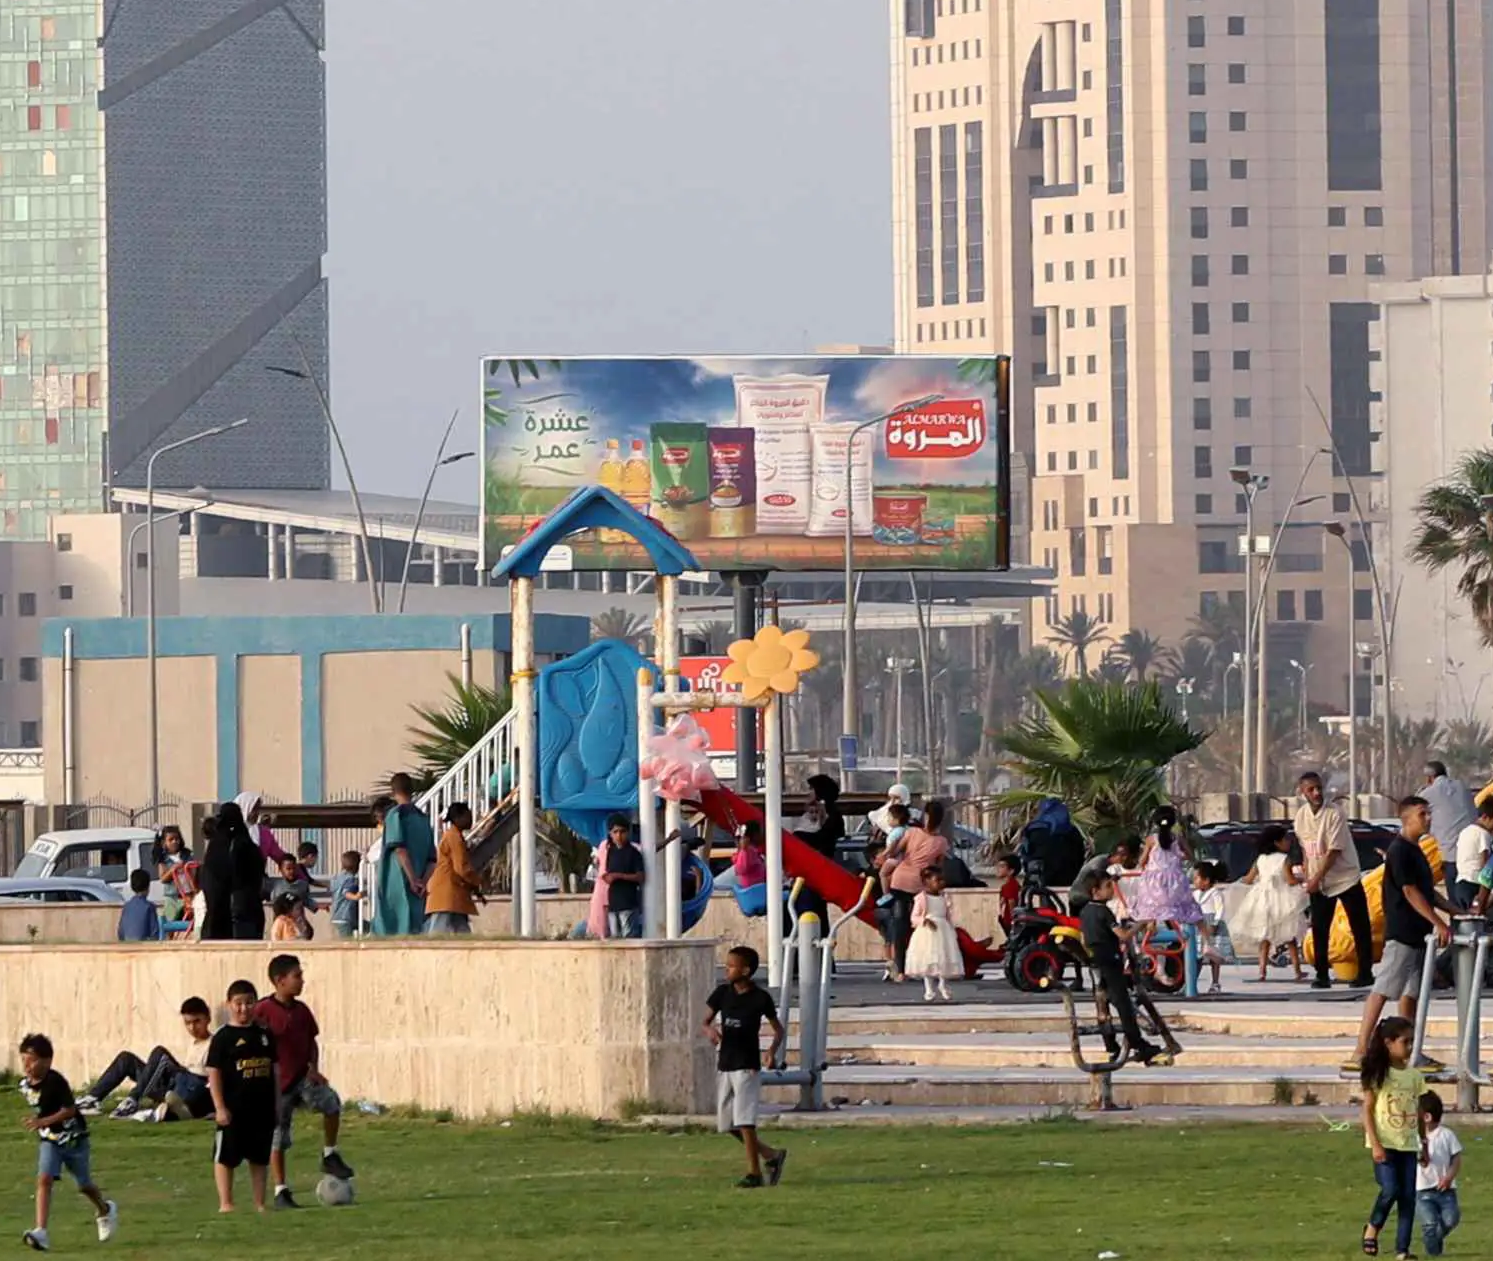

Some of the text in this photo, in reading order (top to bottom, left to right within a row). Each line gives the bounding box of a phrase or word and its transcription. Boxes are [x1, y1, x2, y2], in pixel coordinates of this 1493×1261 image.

[524, 408, 590, 436] عشرة
[903, 413, 966, 425] ALMARWA
[888, 417, 982, 451] المروة
[533, 442, 581, 463] عمر
